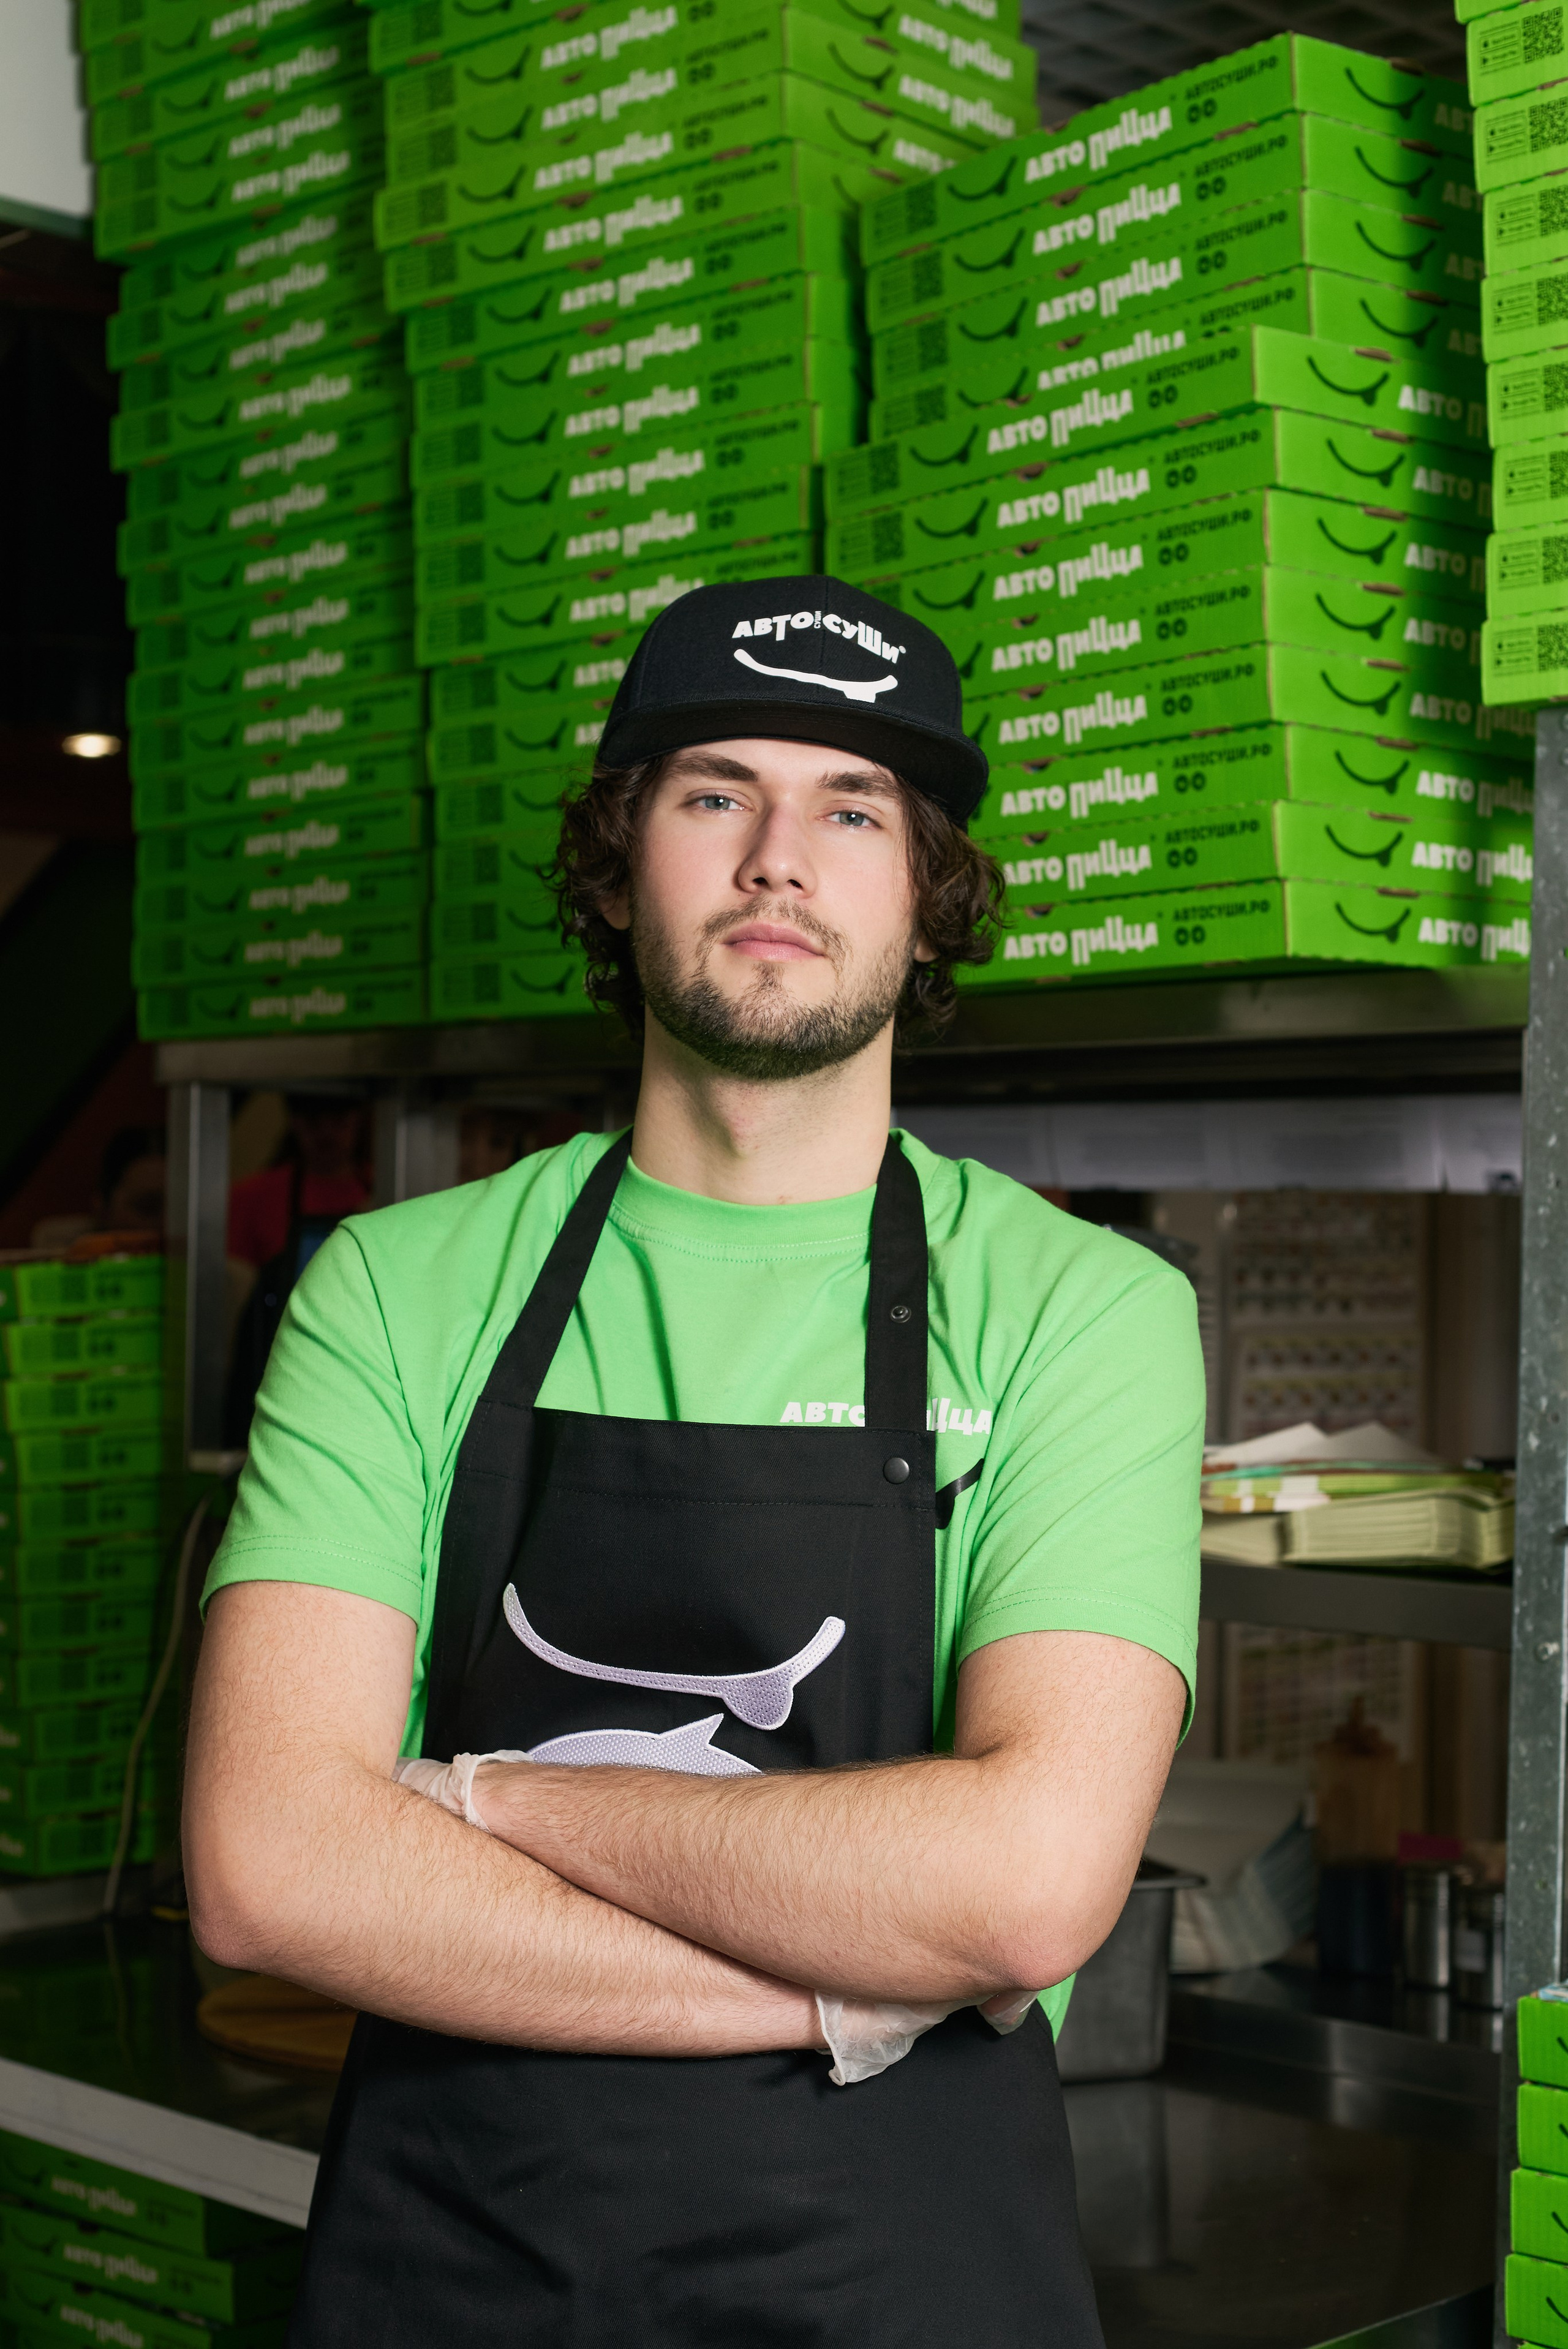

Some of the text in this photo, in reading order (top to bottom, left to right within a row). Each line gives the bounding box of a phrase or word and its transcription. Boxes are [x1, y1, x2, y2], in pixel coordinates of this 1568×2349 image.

[1025, 107, 1172, 182] АВТО ПИЦЦА
[1033, 183, 1180, 254] АВТО ПИЦЦА
[1037, 257, 1182, 326] АВТО ПИЦЦА
[988, 389, 1133, 453] АВТО ПИЦЦА
[997, 467, 1150, 527] АВТО ПИЦЦА
[994, 543, 1143, 600] АВТО ПИЦЦА
[731, 611, 814, 641] АВТО
[823, 614, 899, 664] СУШИ
[992, 616, 1141, 671] АВТО ПИЦЦА
[999, 692, 1147, 744] АВТО ПИЦЦА
[1001, 767, 1158, 818] АВТО ПИЦЦА
[1415, 771, 1475, 802] АВТО
[1066, 840, 1152, 890] ПИЦЦА
[1411, 842, 1471, 872] АВТО
[1004, 916, 1158, 965] АВТО ПИЦЦА
[1418, 917, 1478, 947] АВТО
[927, 1398, 991, 1436] ЦЦА
